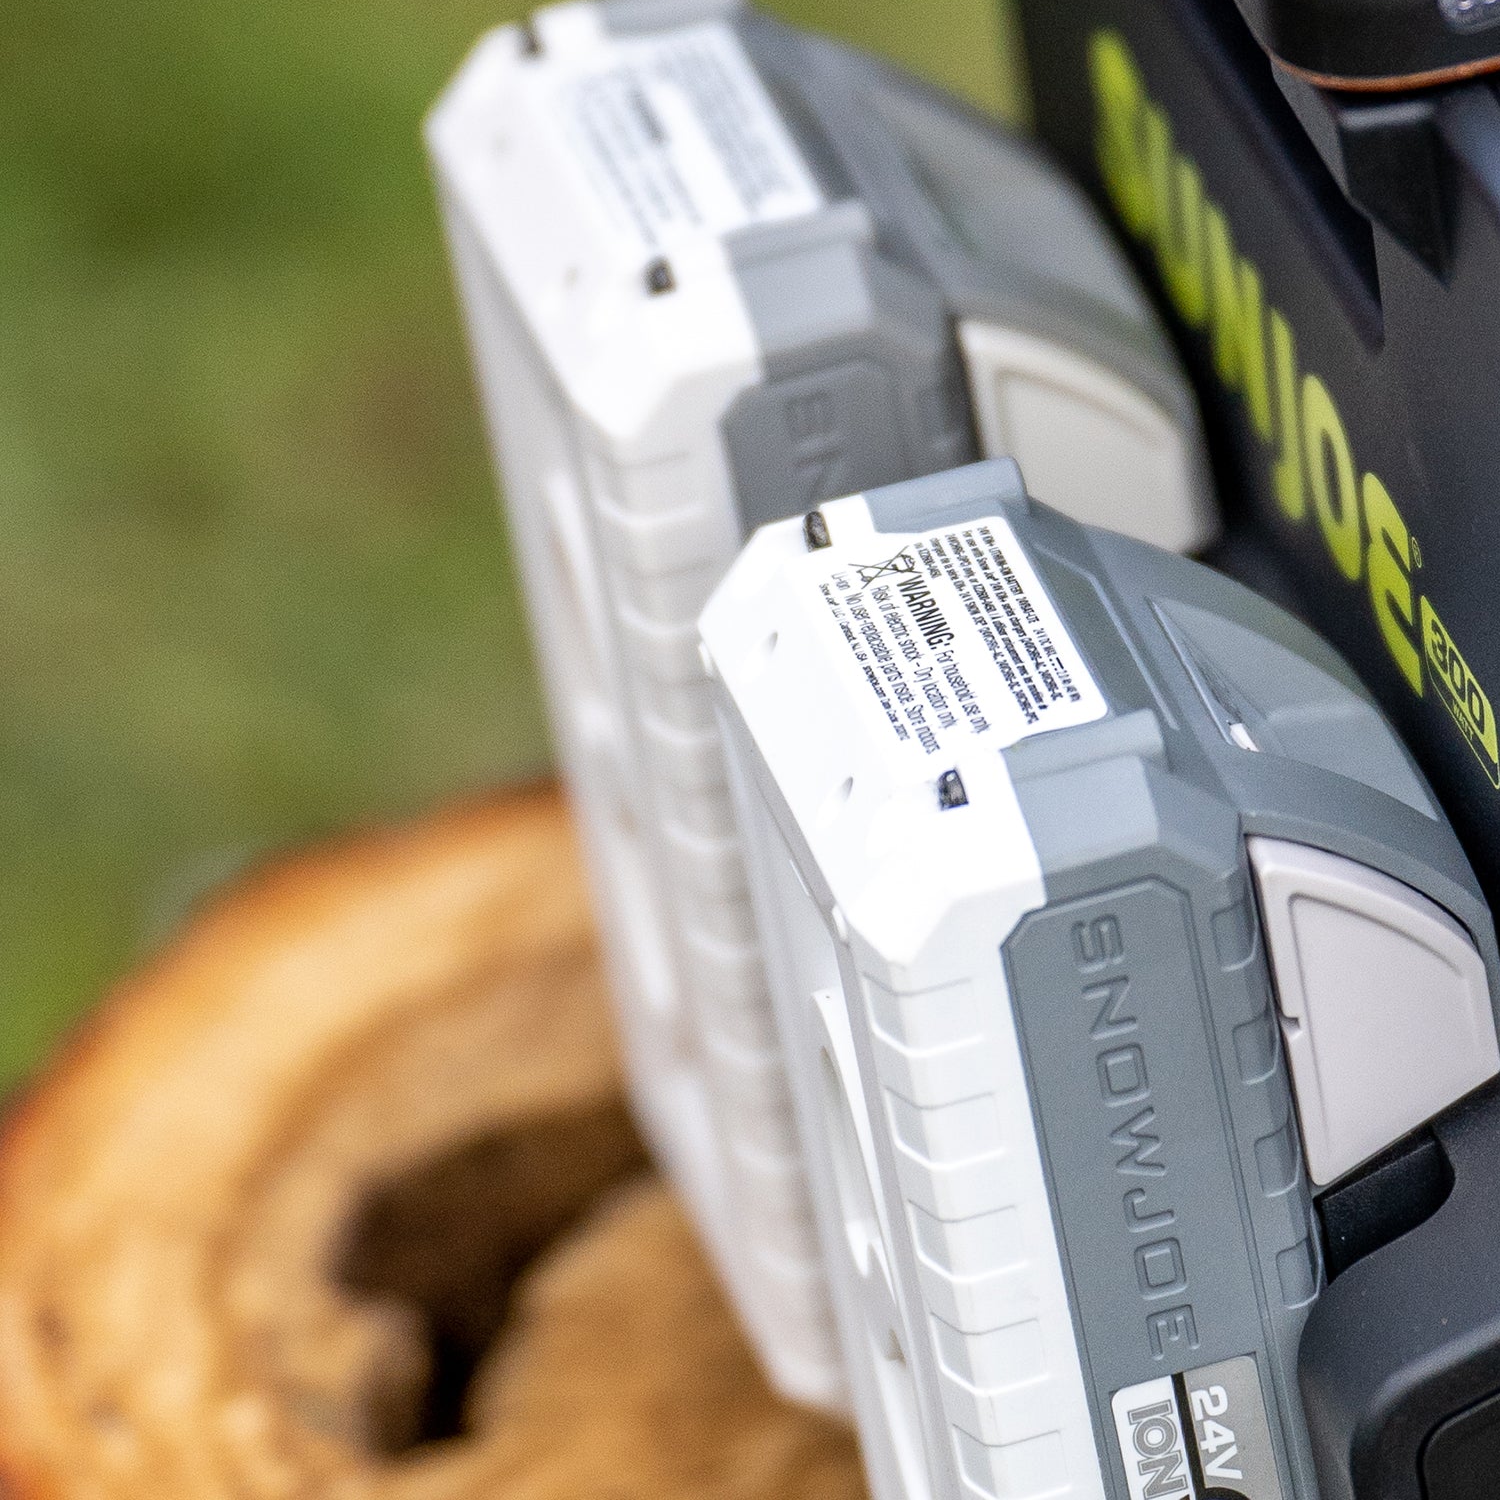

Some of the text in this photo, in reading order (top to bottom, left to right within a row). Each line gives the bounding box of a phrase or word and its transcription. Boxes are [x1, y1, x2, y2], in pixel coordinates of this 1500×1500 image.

[868, 584, 895, 604] Risk
[1003, 574, 1024, 596] BATTERY
[843, 591, 866, 606] No
[877, 600, 899, 613] of
[882, 609, 914, 640] electric
[893, 574, 959, 650] WARNING:
[845, 602, 897, 665] user-replaceable
[897, 637, 926, 662] shock
[933, 648, 958, 665] For
[876, 660, 906, 684] parts
[908, 665, 938, 685] Dry
[940, 661, 978, 703] household
[1430, 618, 1485, 736] 300
[920, 680, 953, 712] location
[902, 702, 931, 726] Store
[961, 701, 981, 717] use
[1071, 913, 1200, 1361] SNOWJOE
[1191, 1385, 1243, 1480] 24V
[1128, 1399, 1189, 1499] ION
